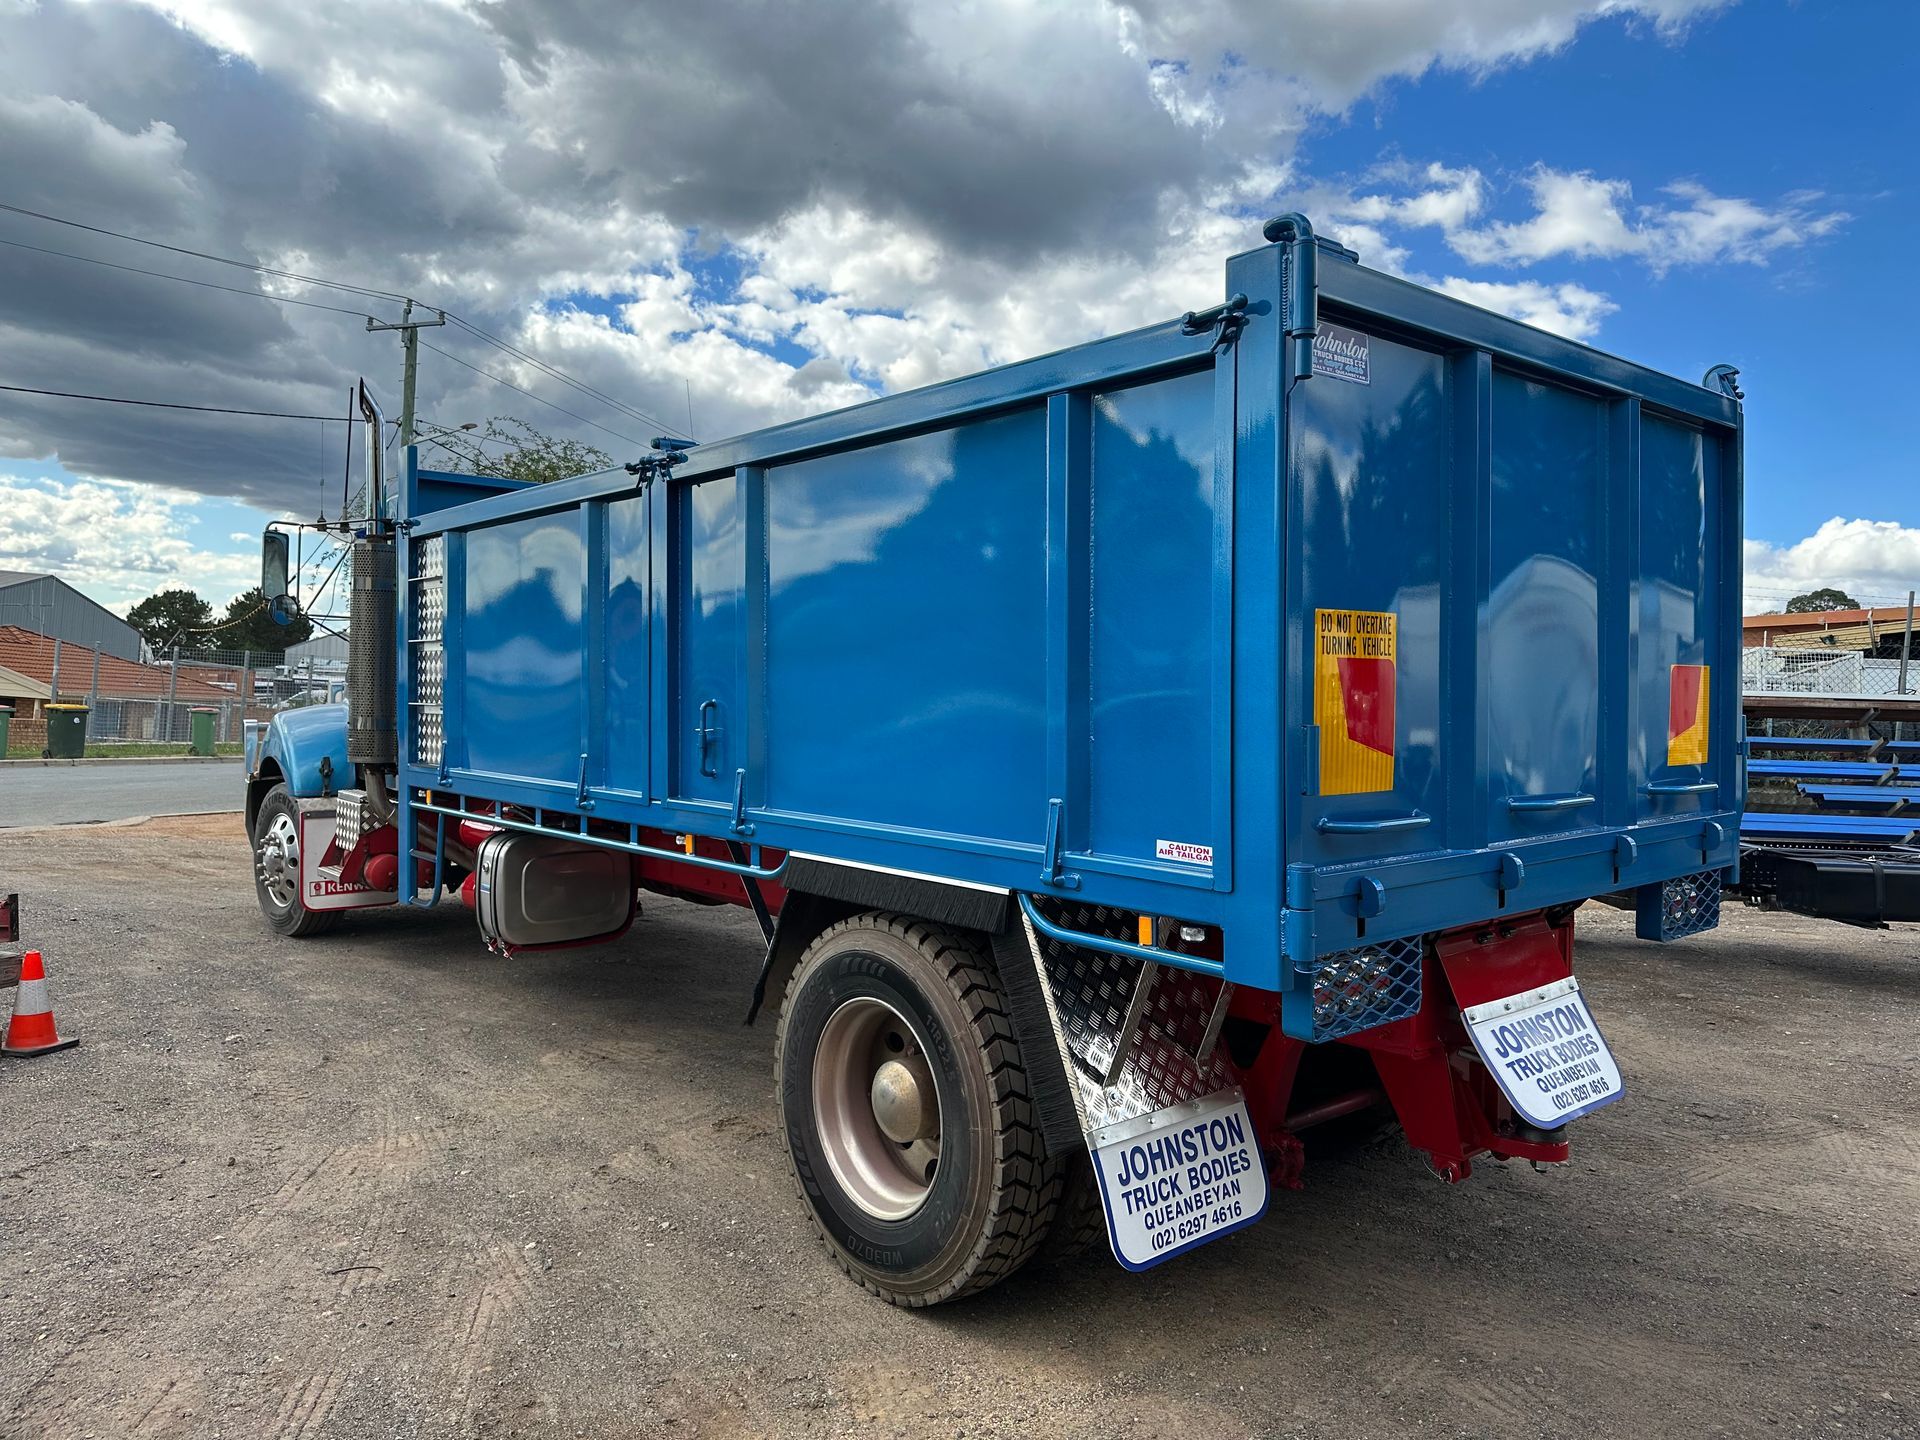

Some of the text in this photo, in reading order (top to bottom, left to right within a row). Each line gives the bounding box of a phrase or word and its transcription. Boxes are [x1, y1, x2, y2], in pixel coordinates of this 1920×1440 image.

[1313, 350, 1333, 360] TRUCK
[1334, 355, 1354, 365] BODIES
[1321, 613, 1392, 634] DO NOT OVERTAKE
[1321, 636, 1392, 656] TURNING VEHICLE
[1158, 848, 1174, 856] AIR
[1168, 843, 1210, 855] CAUTION
[327, 882, 371, 893] KENW
[1490, 1003, 1588, 1058] JOHNSTON
[1505, 1034, 1600, 1081] TRUCK BODIES
[1536, 1058, 1601, 1093] QUEANBEYAN
[1551, 1076, 1610, 1110] (02) 6297 4616
[1117, 1113, 1246, 1186] JOHNSTON
[1121, 1149, 1251, 1216] TRUCK BODIES
[1144, 1178, 1241, 1230] QUEANBEYAN
[1151, 1201, 1242, 1250] (02) 6297 4616
